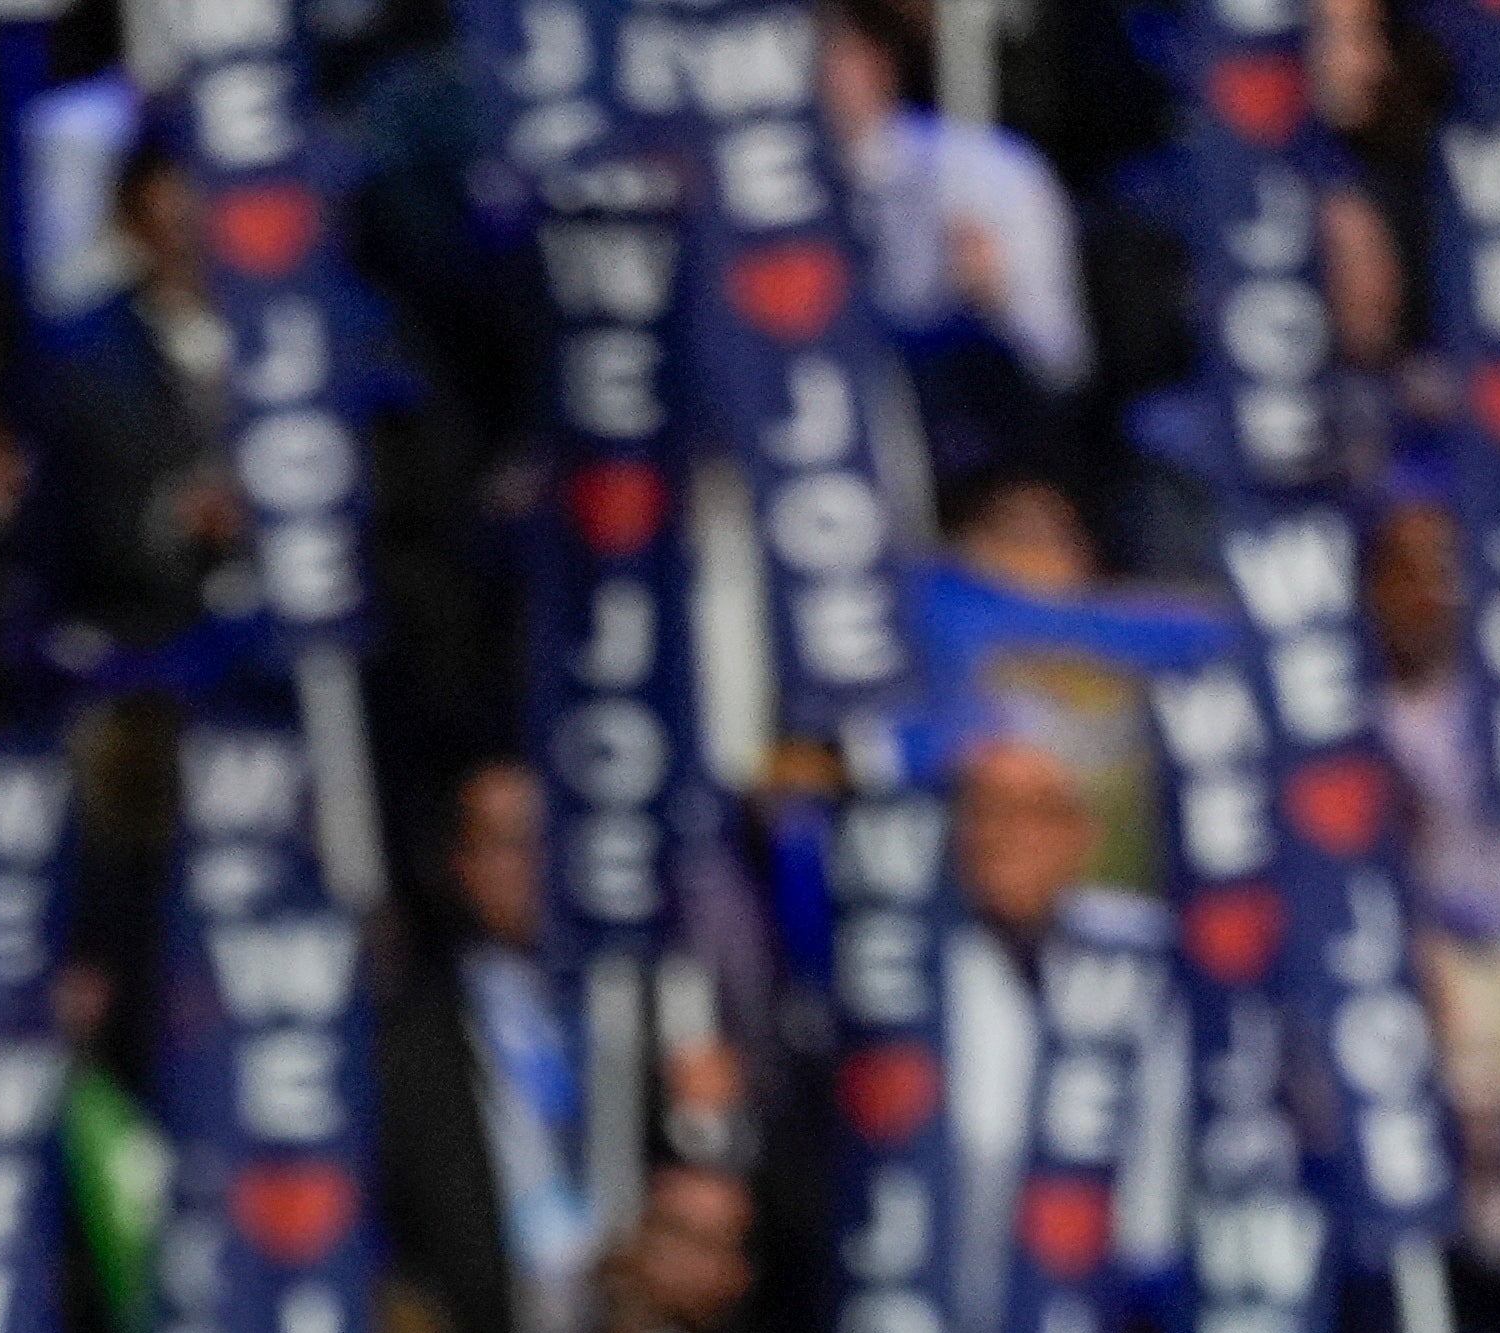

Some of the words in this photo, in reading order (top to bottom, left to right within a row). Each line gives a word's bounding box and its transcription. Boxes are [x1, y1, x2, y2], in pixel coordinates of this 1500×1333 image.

[230, 300, 355, 618] JOE
[540, 225, 680, 440] WE
[690, 30, 830, 222] WE
[770, 360, 900, 685] JOE
[1220, 180, 1330, 465] JOE
[560, 580, 672, 920] JOE
[1155, 680, 1265, 875] WE
[1220, 520, 1360, 742] WE
[1325, 880, 1452, 1212] JOE
[210, 920, 365, 1150] WE
[835, 805, 945, 1022] WE
